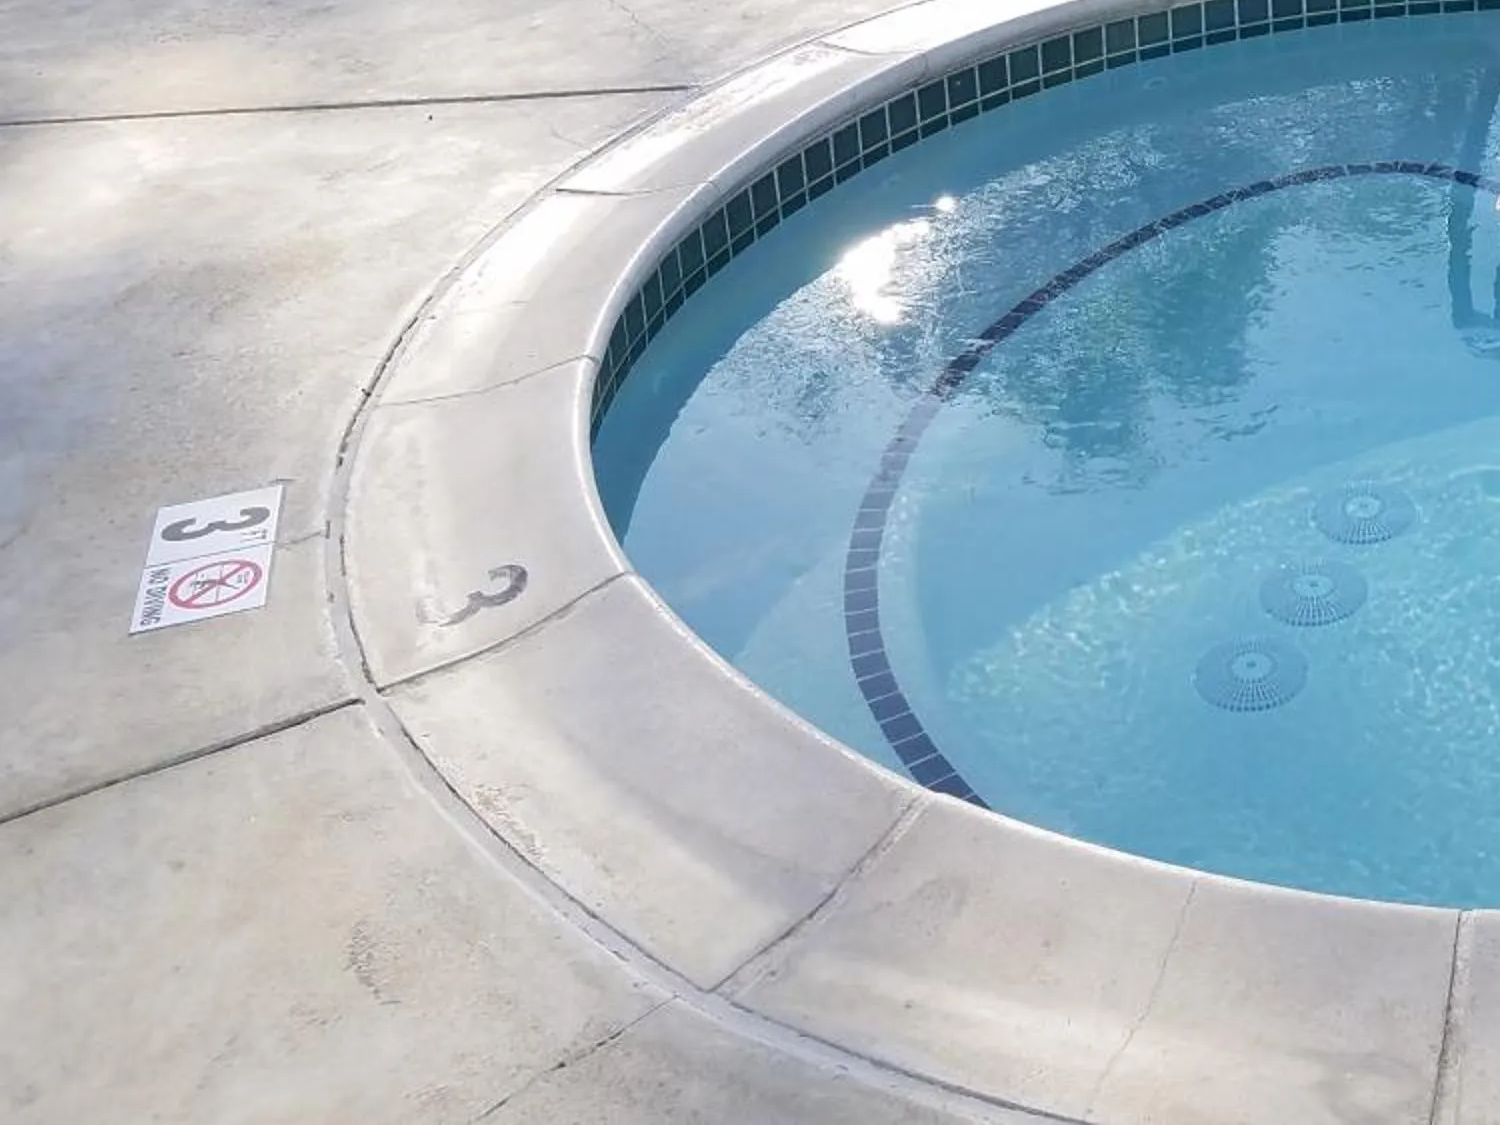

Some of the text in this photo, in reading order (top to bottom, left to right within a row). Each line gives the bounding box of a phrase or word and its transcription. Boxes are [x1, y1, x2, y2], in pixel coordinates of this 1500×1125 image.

[161, 506, 271, 542] 3
[140, 567, 170, 626] NO DIVING
[417, 564, 529, 627] 3
